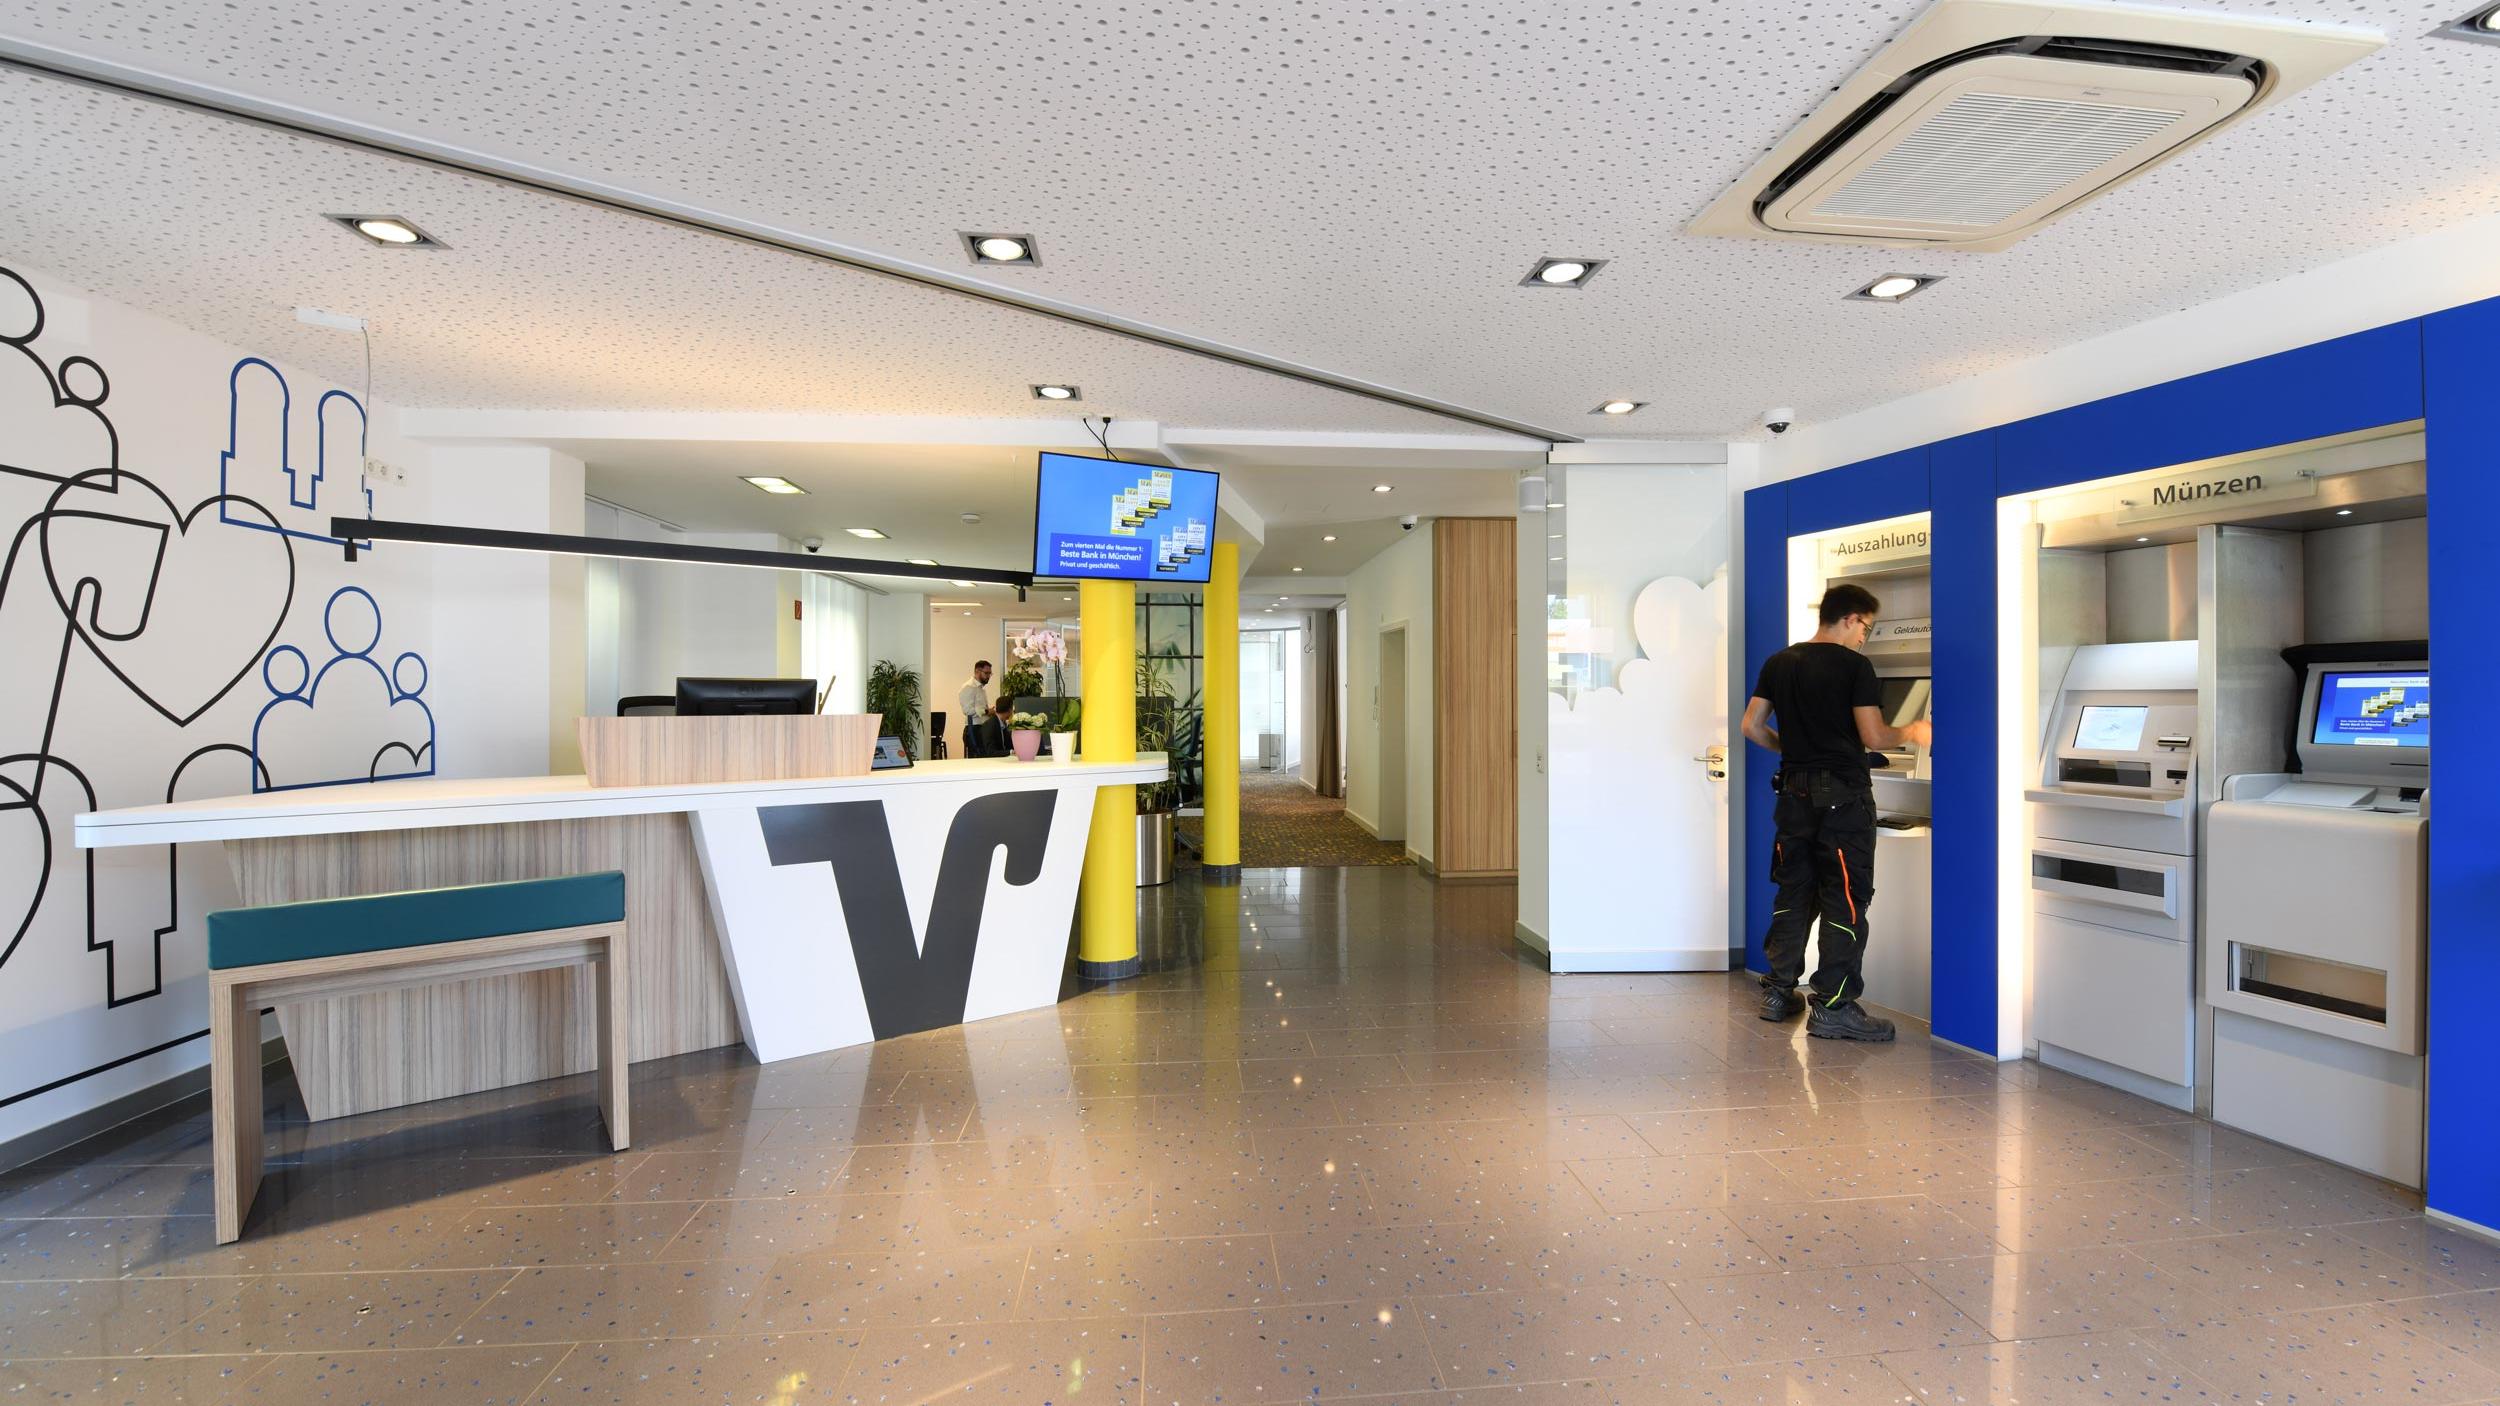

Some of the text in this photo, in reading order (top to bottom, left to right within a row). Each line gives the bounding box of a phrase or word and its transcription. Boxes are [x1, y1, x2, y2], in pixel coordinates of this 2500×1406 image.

[2153, 475, 2261, 505] Münzen
[1060, 550, 1080, 558] Beste
[1081, 551, 1098, 559] Bank
[1108, 553, 1141, 561] München!
[1838, 531, 1927, 556] Auszahlung
